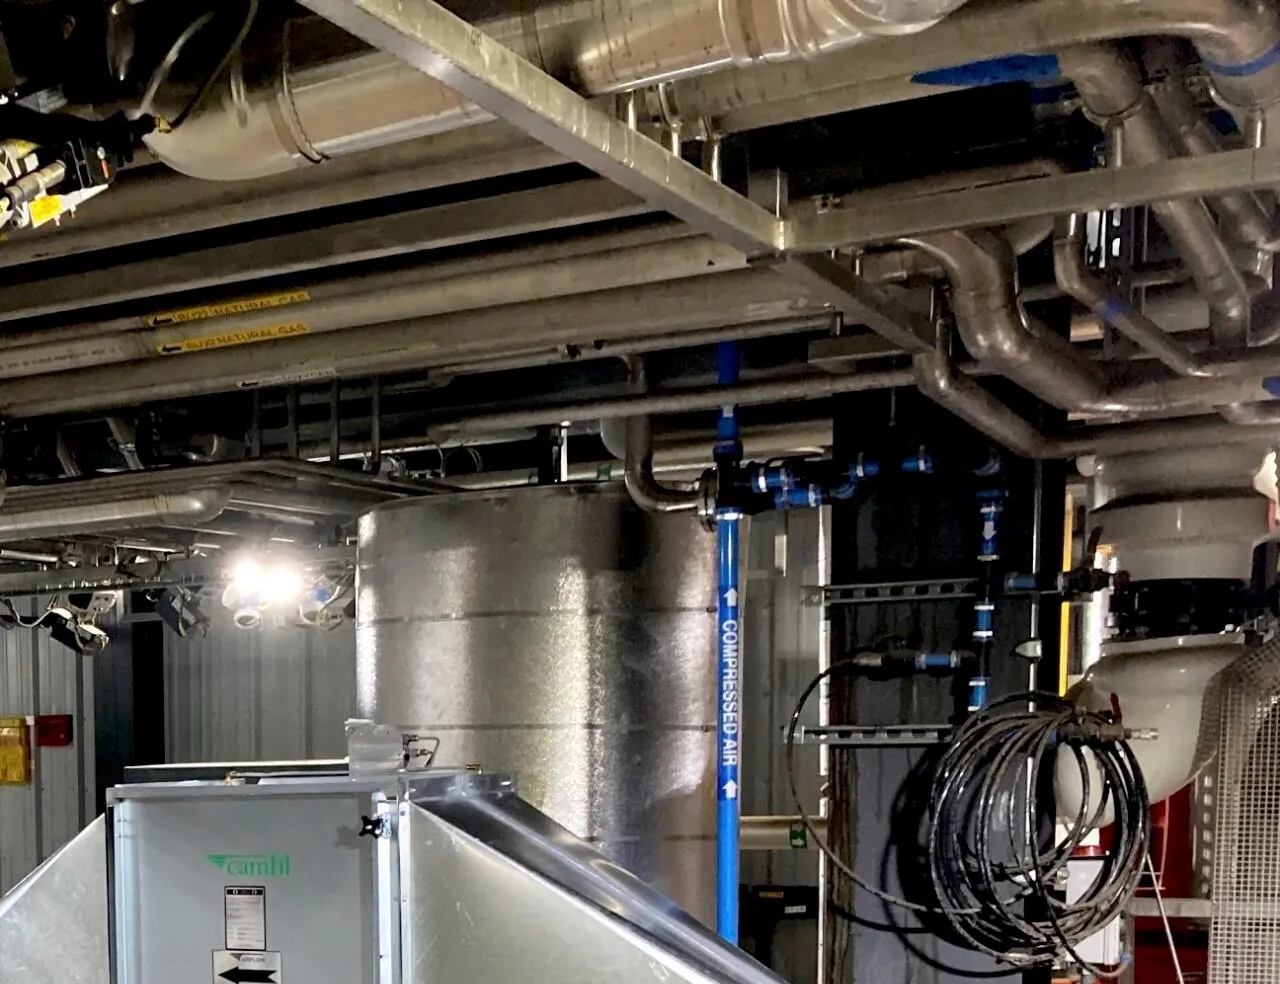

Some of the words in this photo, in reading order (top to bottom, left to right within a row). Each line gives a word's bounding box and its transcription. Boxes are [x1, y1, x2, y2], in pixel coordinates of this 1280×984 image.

[722, 619, 738, 734] COMPRESSED
[722, 739, 738, 766] AIR
[227, 853, 290, 876] camfil
